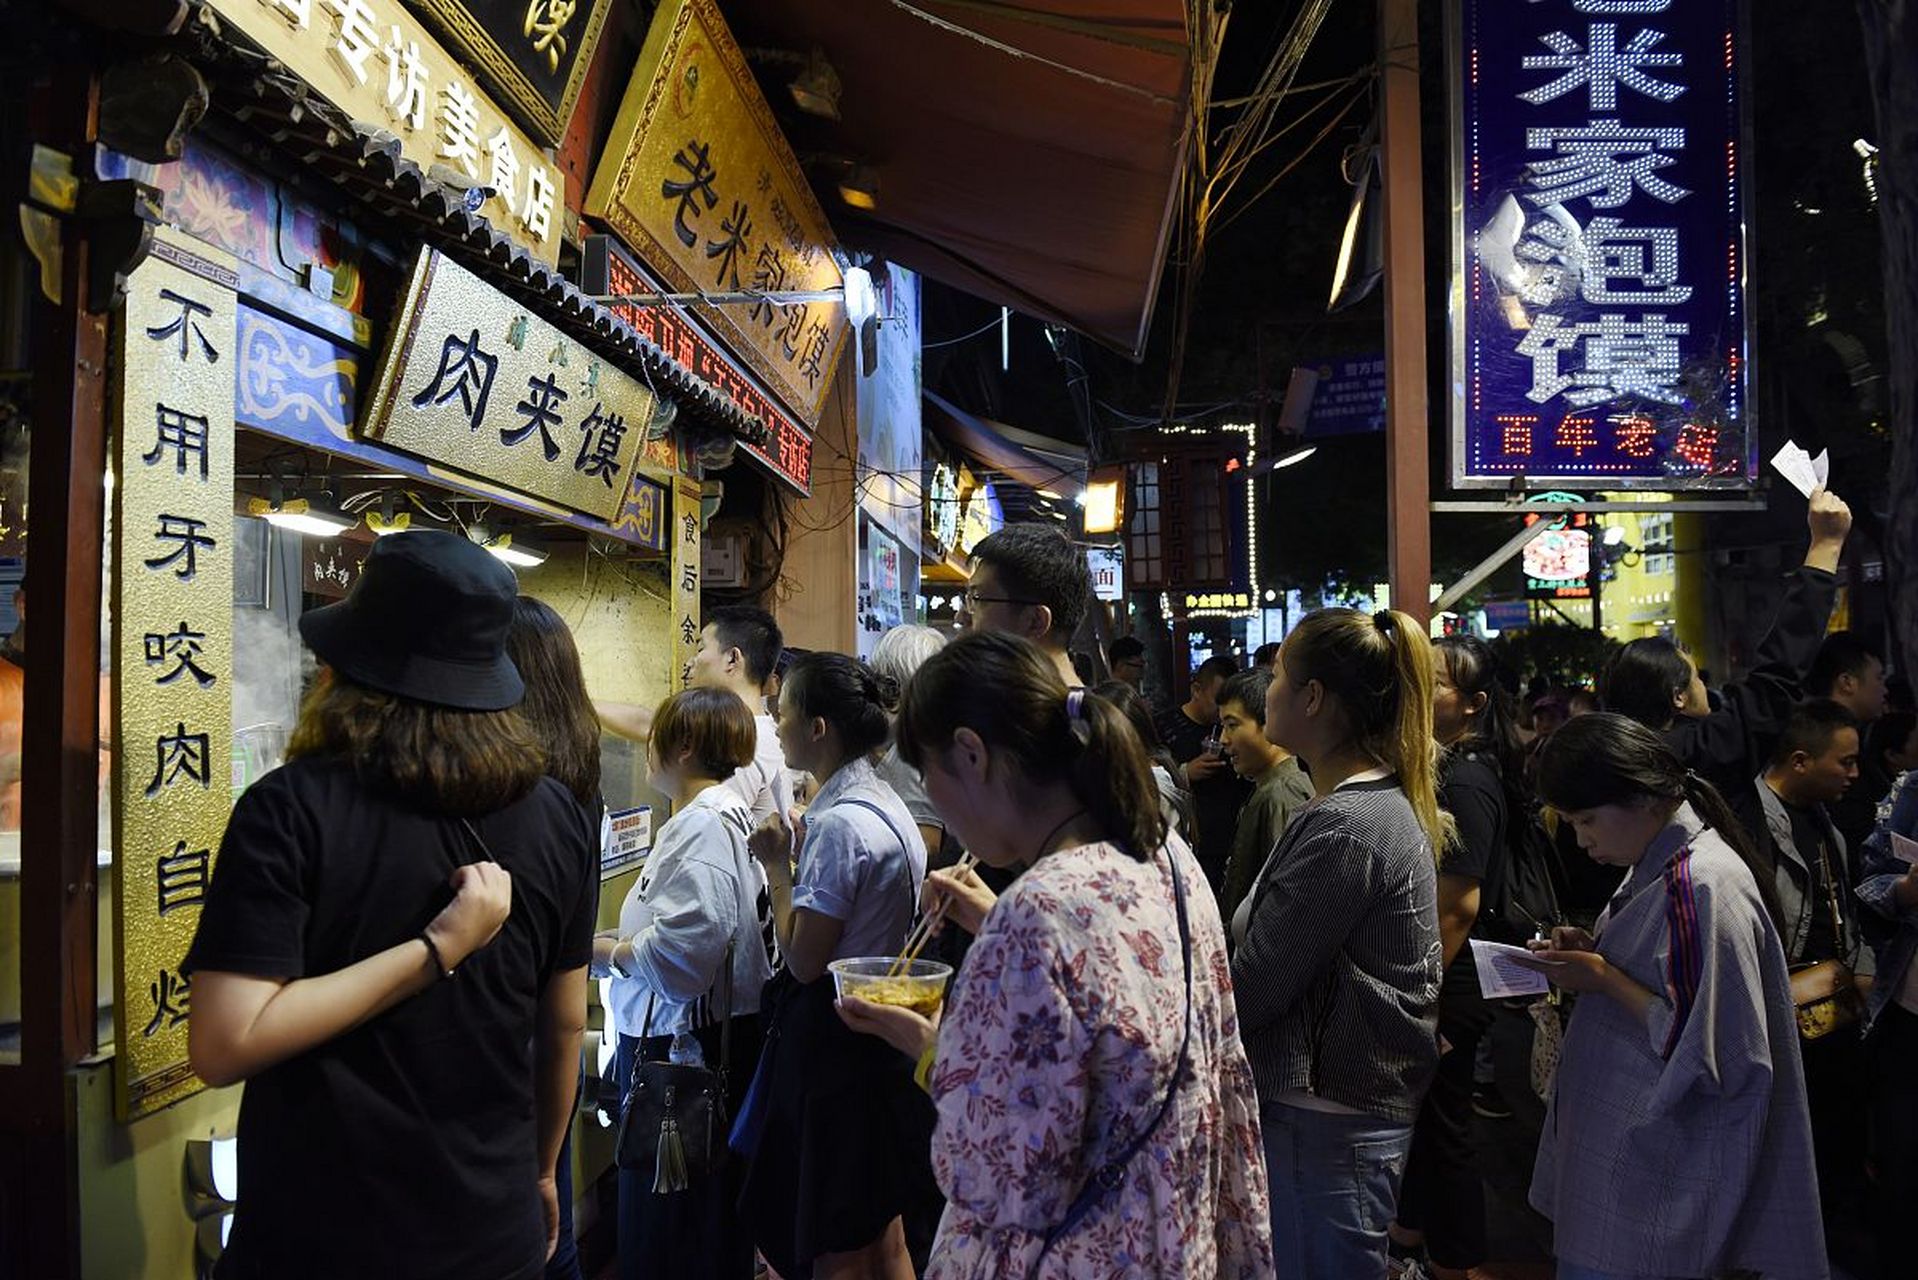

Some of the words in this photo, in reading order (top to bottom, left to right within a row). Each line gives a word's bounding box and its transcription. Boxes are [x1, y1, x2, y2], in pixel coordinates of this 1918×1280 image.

[661, 139, 830, 388] 老米家泡馍
[1514, 0, 1694, 406] 米家泡馍
[411, 328, 628, 490] 肉夹馍
